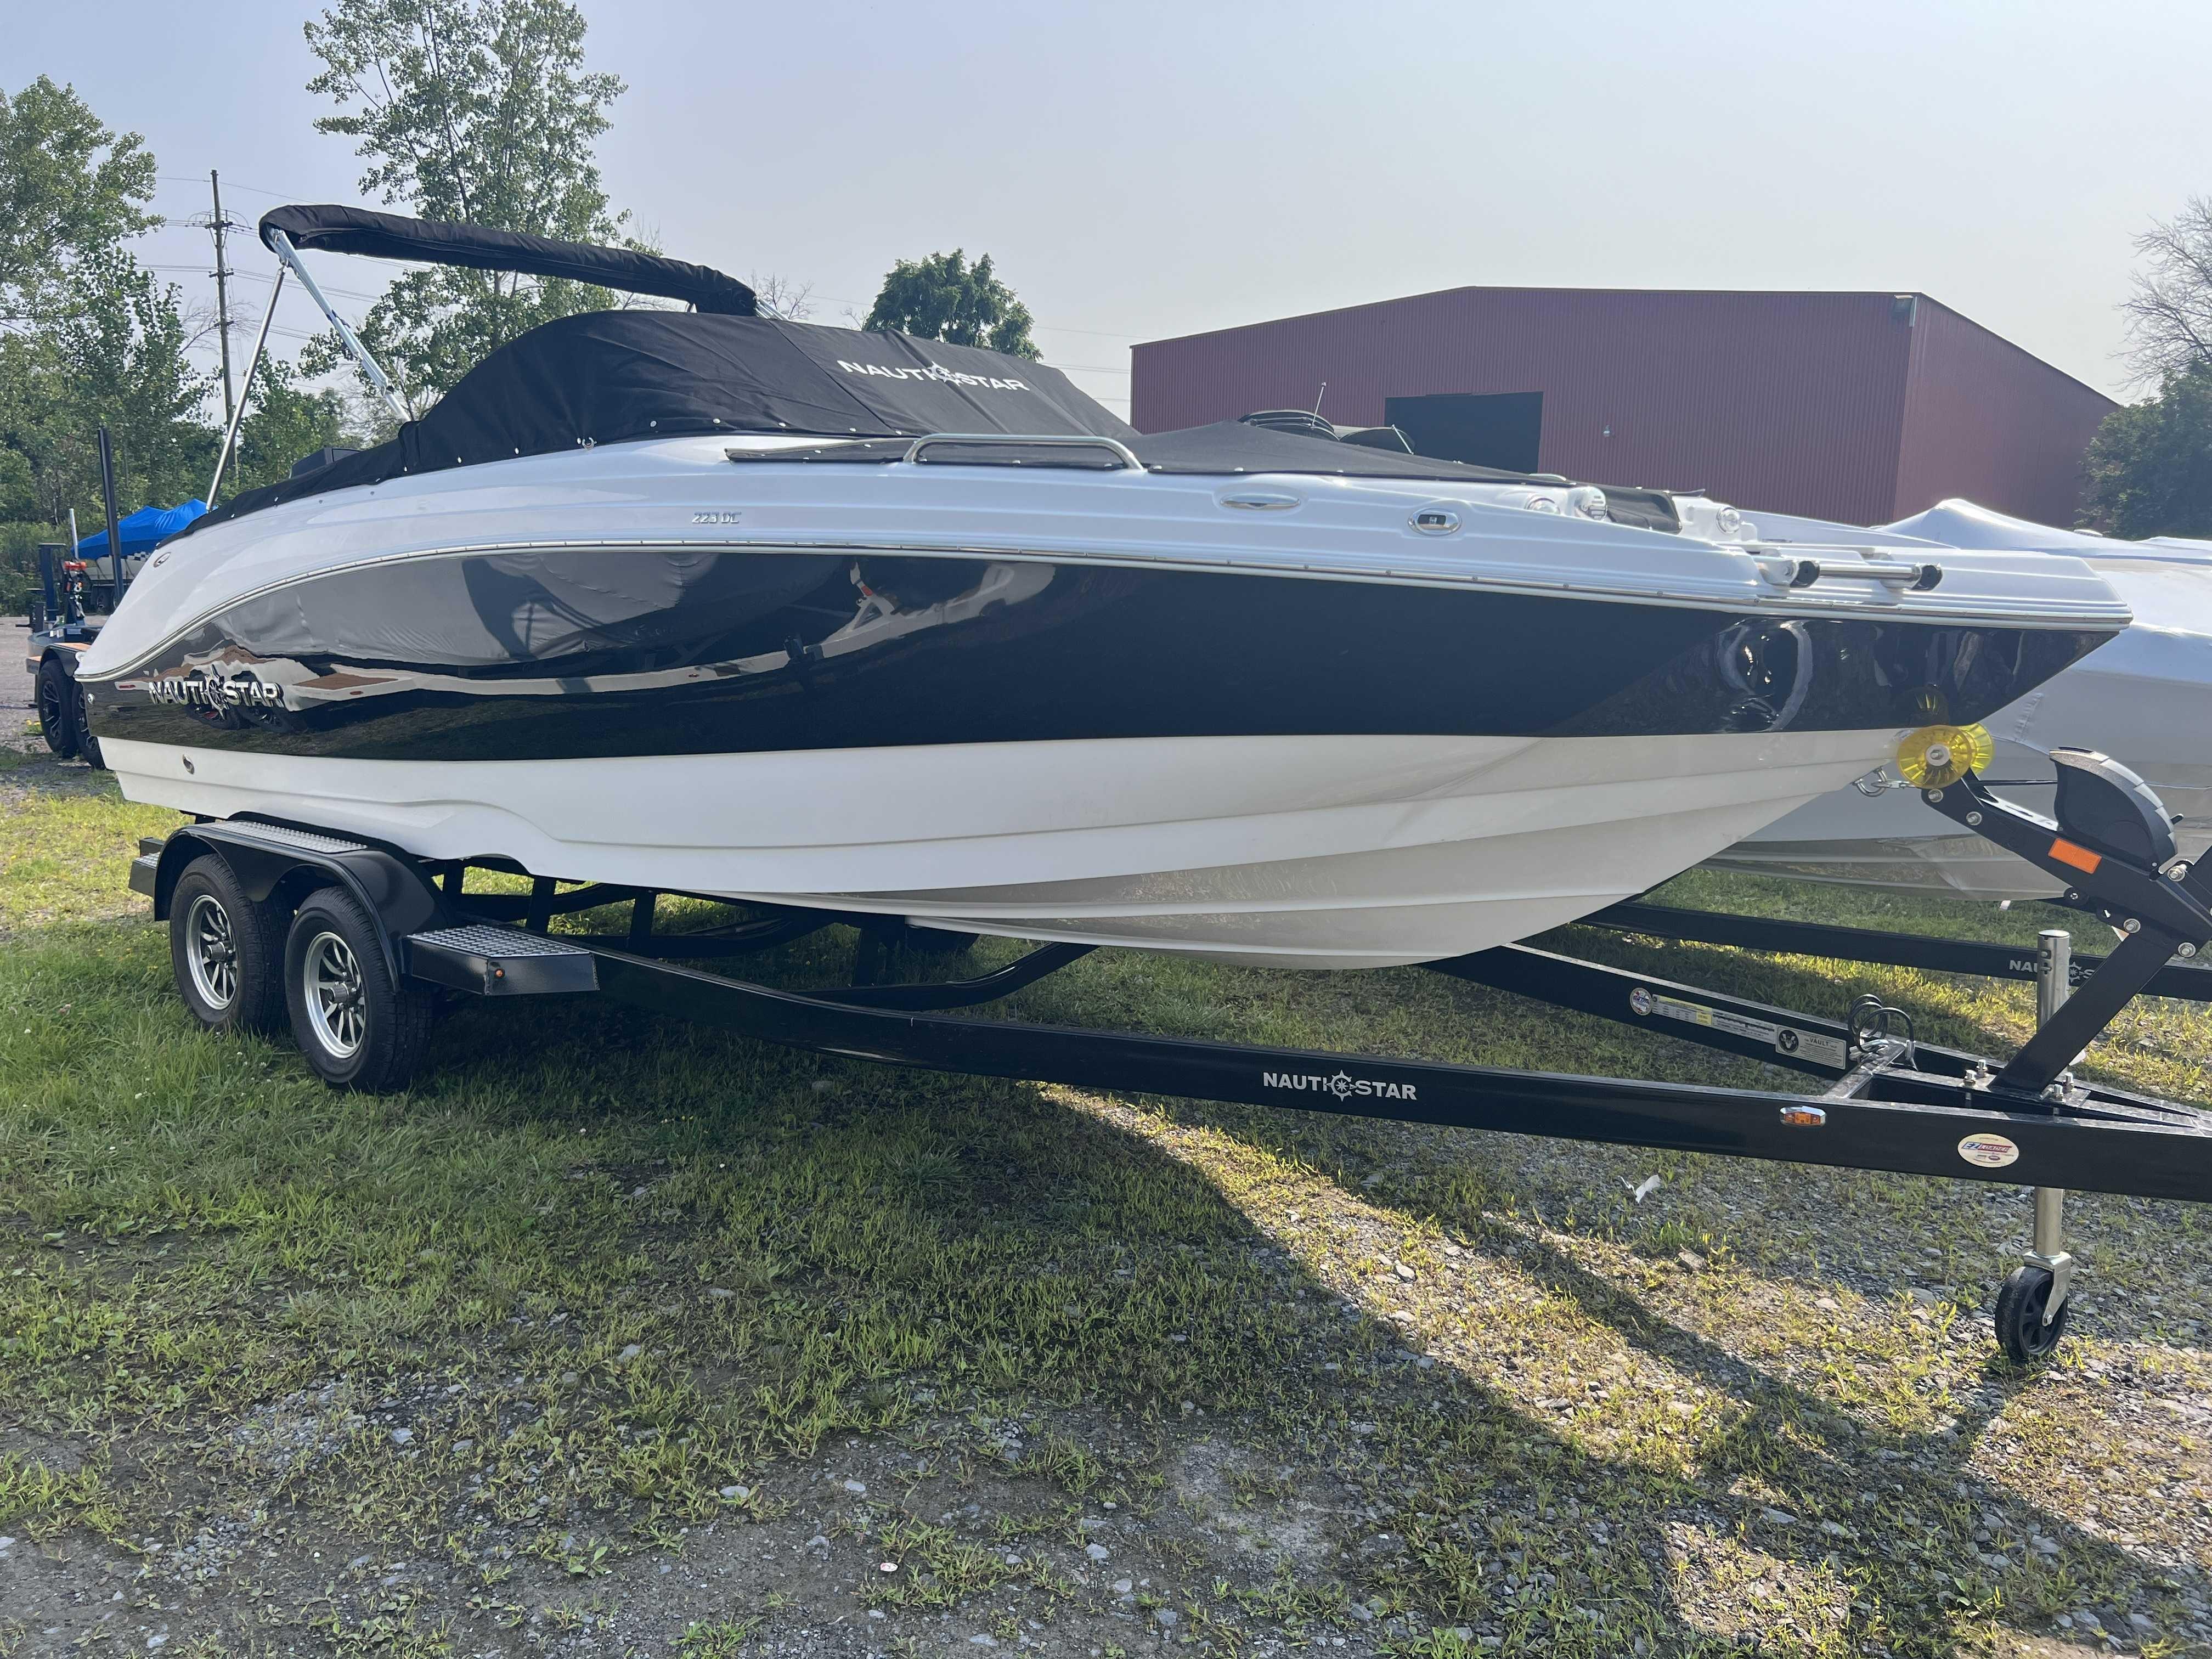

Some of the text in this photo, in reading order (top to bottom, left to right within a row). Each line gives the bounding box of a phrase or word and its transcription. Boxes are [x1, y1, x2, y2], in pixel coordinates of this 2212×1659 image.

[692, 512, 742, 523] 223 DC
[1809, 1037, 1829, 1047] VAULT
